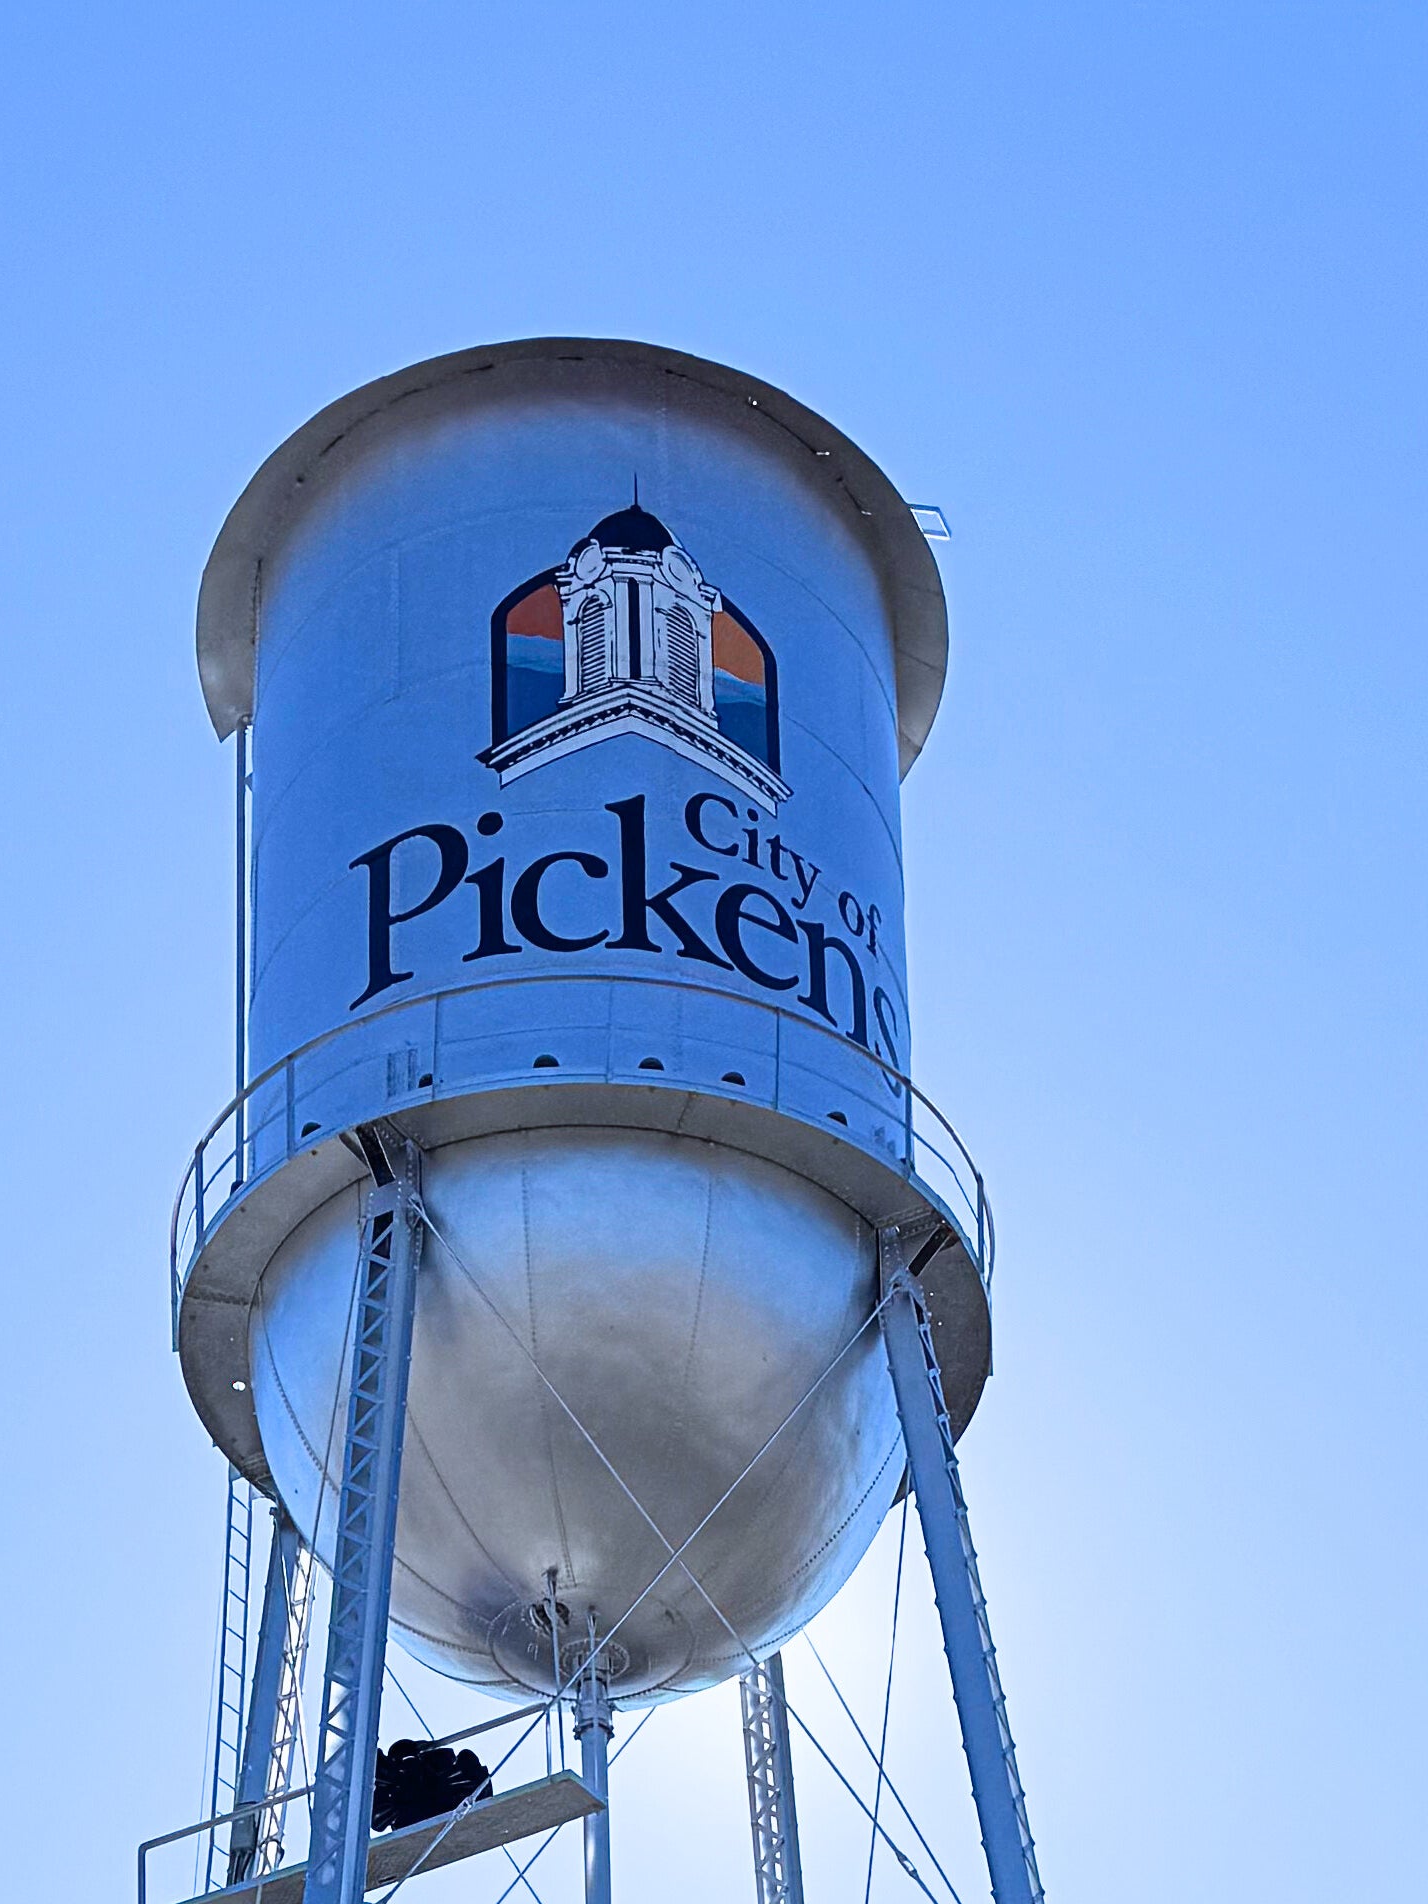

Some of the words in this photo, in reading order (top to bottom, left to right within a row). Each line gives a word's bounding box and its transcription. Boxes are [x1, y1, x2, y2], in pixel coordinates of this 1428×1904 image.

[348, 794, 902, 1098] Pickens
[684, 792, 822, 910] City
[837, 890, 882, 963] of
